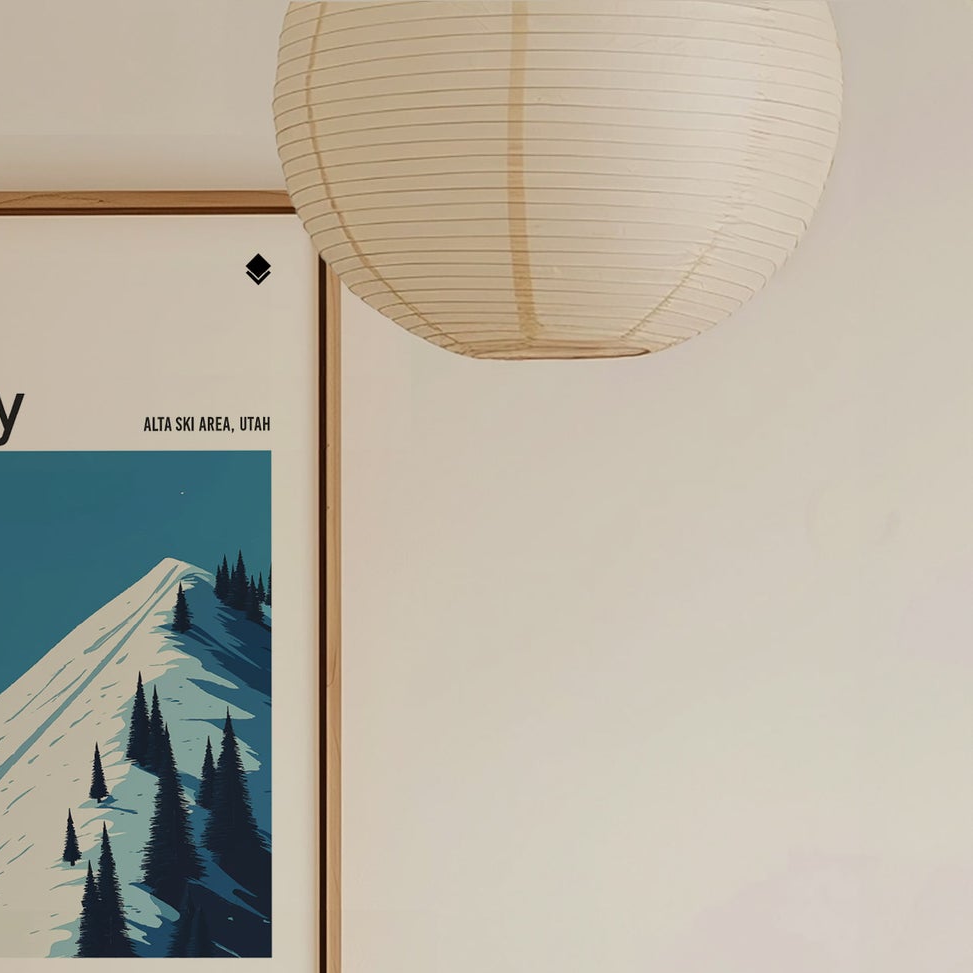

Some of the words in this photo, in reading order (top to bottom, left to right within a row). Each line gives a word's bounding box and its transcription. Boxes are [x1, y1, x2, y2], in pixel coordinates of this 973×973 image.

[143, 416, 173, 432] ALTA
[175, 416, 195, 432] SKI
[198, 416, 235, 434] AREA,
[239, 416, 271, 432] UTAH
